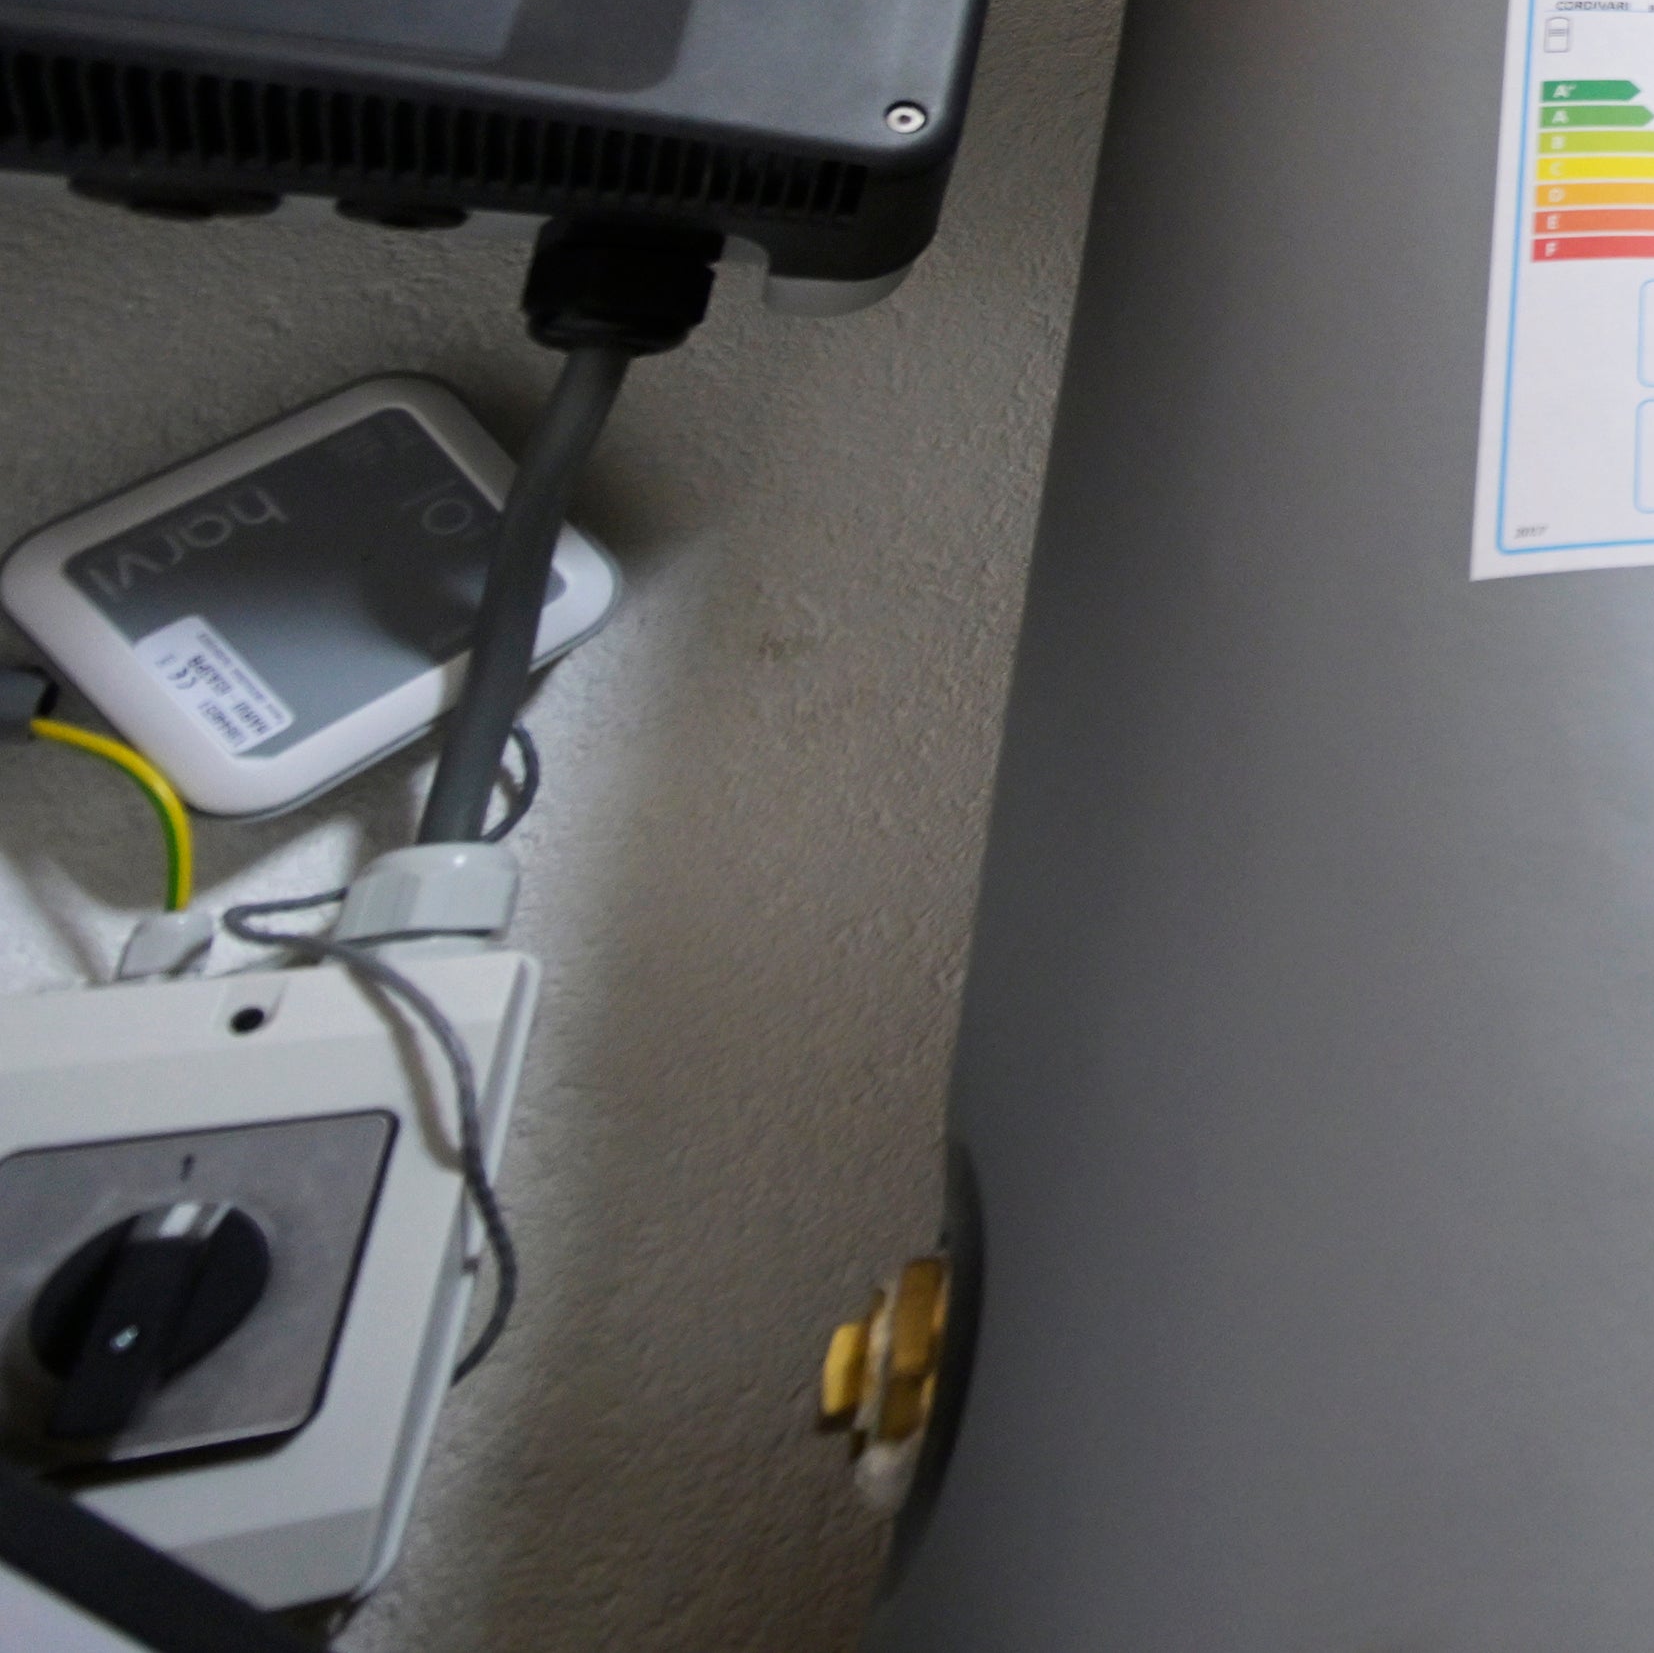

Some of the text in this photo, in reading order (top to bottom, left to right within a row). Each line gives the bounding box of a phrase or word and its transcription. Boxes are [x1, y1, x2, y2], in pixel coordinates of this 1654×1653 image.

[1555, 0, 1629, 11] CORDIVARI
[1552, 109, 1569, 124] A
[1551, 135, 1566, 150] B
[1550, 161, 1563, 177] C
[1547, 214, 1560, 230] E
[1545, 241, 1558, 257] F
[92, 485, 289, 604] harvi
